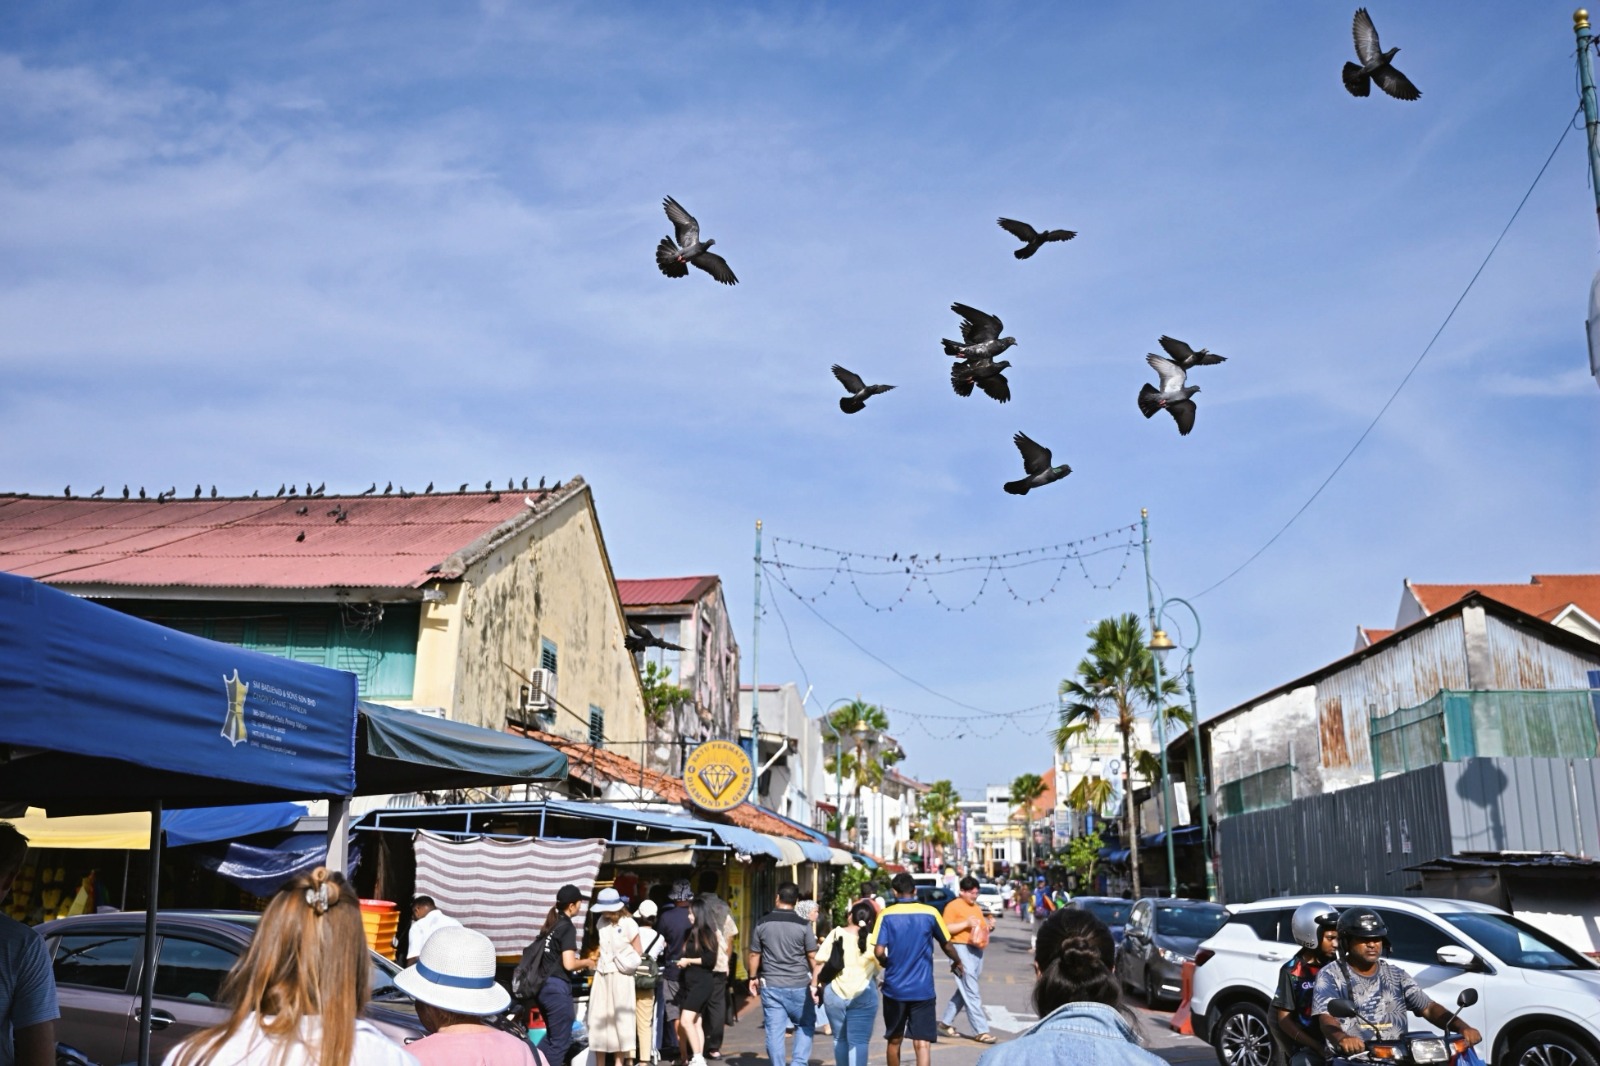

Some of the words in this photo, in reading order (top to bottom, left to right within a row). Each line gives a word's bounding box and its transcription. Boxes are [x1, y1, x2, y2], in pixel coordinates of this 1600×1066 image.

[693, 745, 710, 762] BATU
[712, 744, 746, 763] PERMATA
[687, 776, 720, 807] DIAMOND
[732, 777, 750, 802] GEMS
